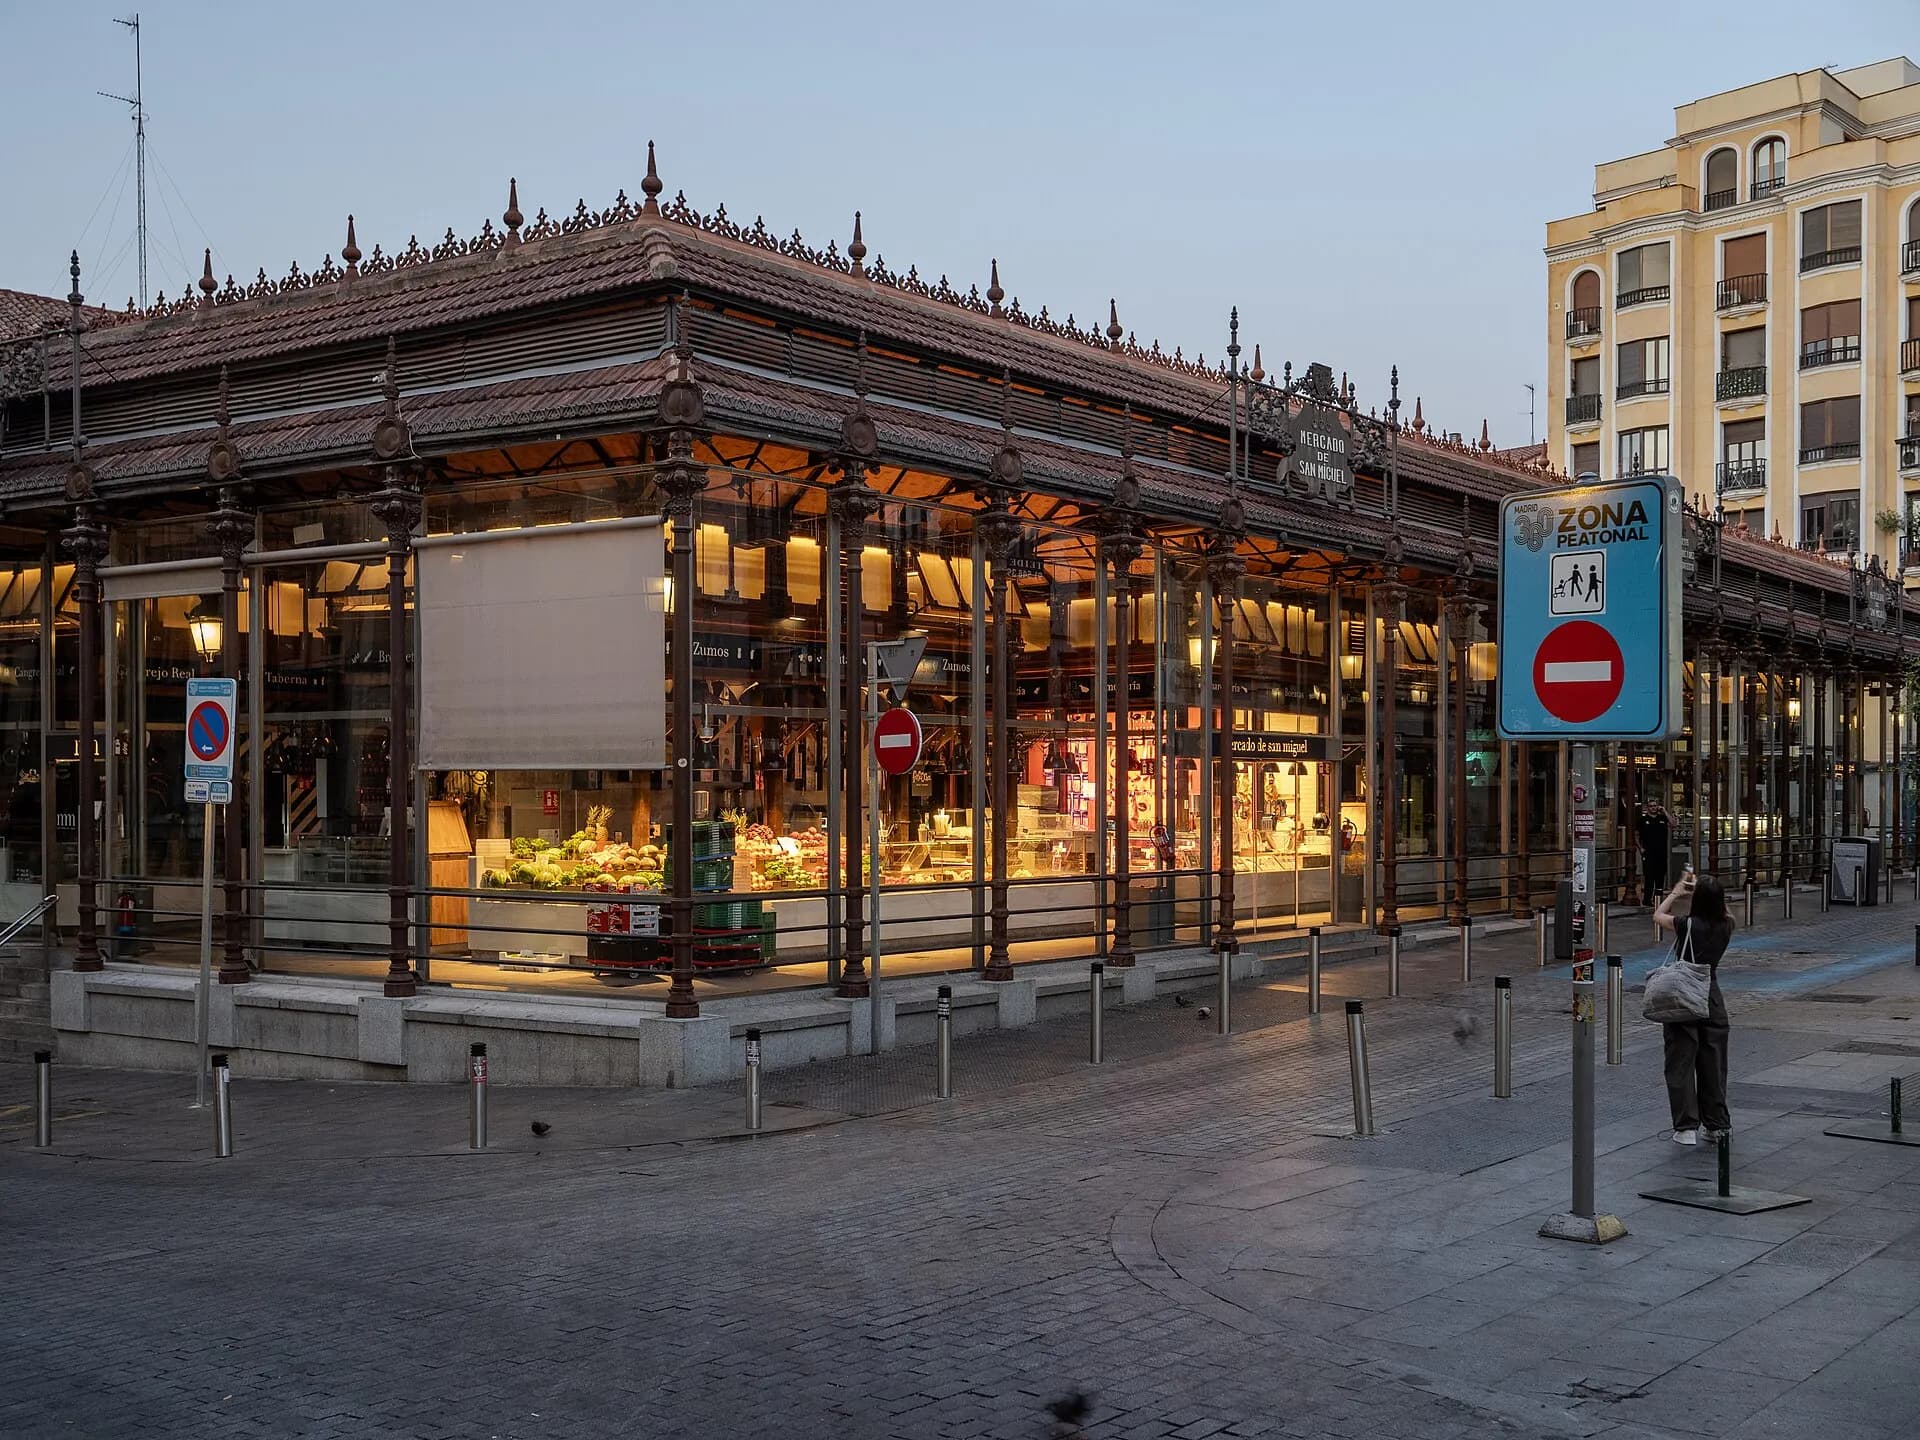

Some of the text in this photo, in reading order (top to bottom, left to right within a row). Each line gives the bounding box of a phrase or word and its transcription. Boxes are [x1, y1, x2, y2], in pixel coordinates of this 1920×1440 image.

[1300, 429, 1345, 454] MERCADO
[1317, 451, 1329, 463] DE
[1299, 460, 1316, 477] SAN
[1514, 504, 1538, 513] MADRID
[1557, 500, 1649, 533] ZONA
[1513, 506, 1554, 552] 360
[1557, 526, 1650, 548] PEATONAL
[692, 641, 730, 658] Zumos
[942, 658, 971, 673] Zumos
[264, 671, 307, 686] Taberna
[1231, 737, 1308, 757] ercado de san miguel
